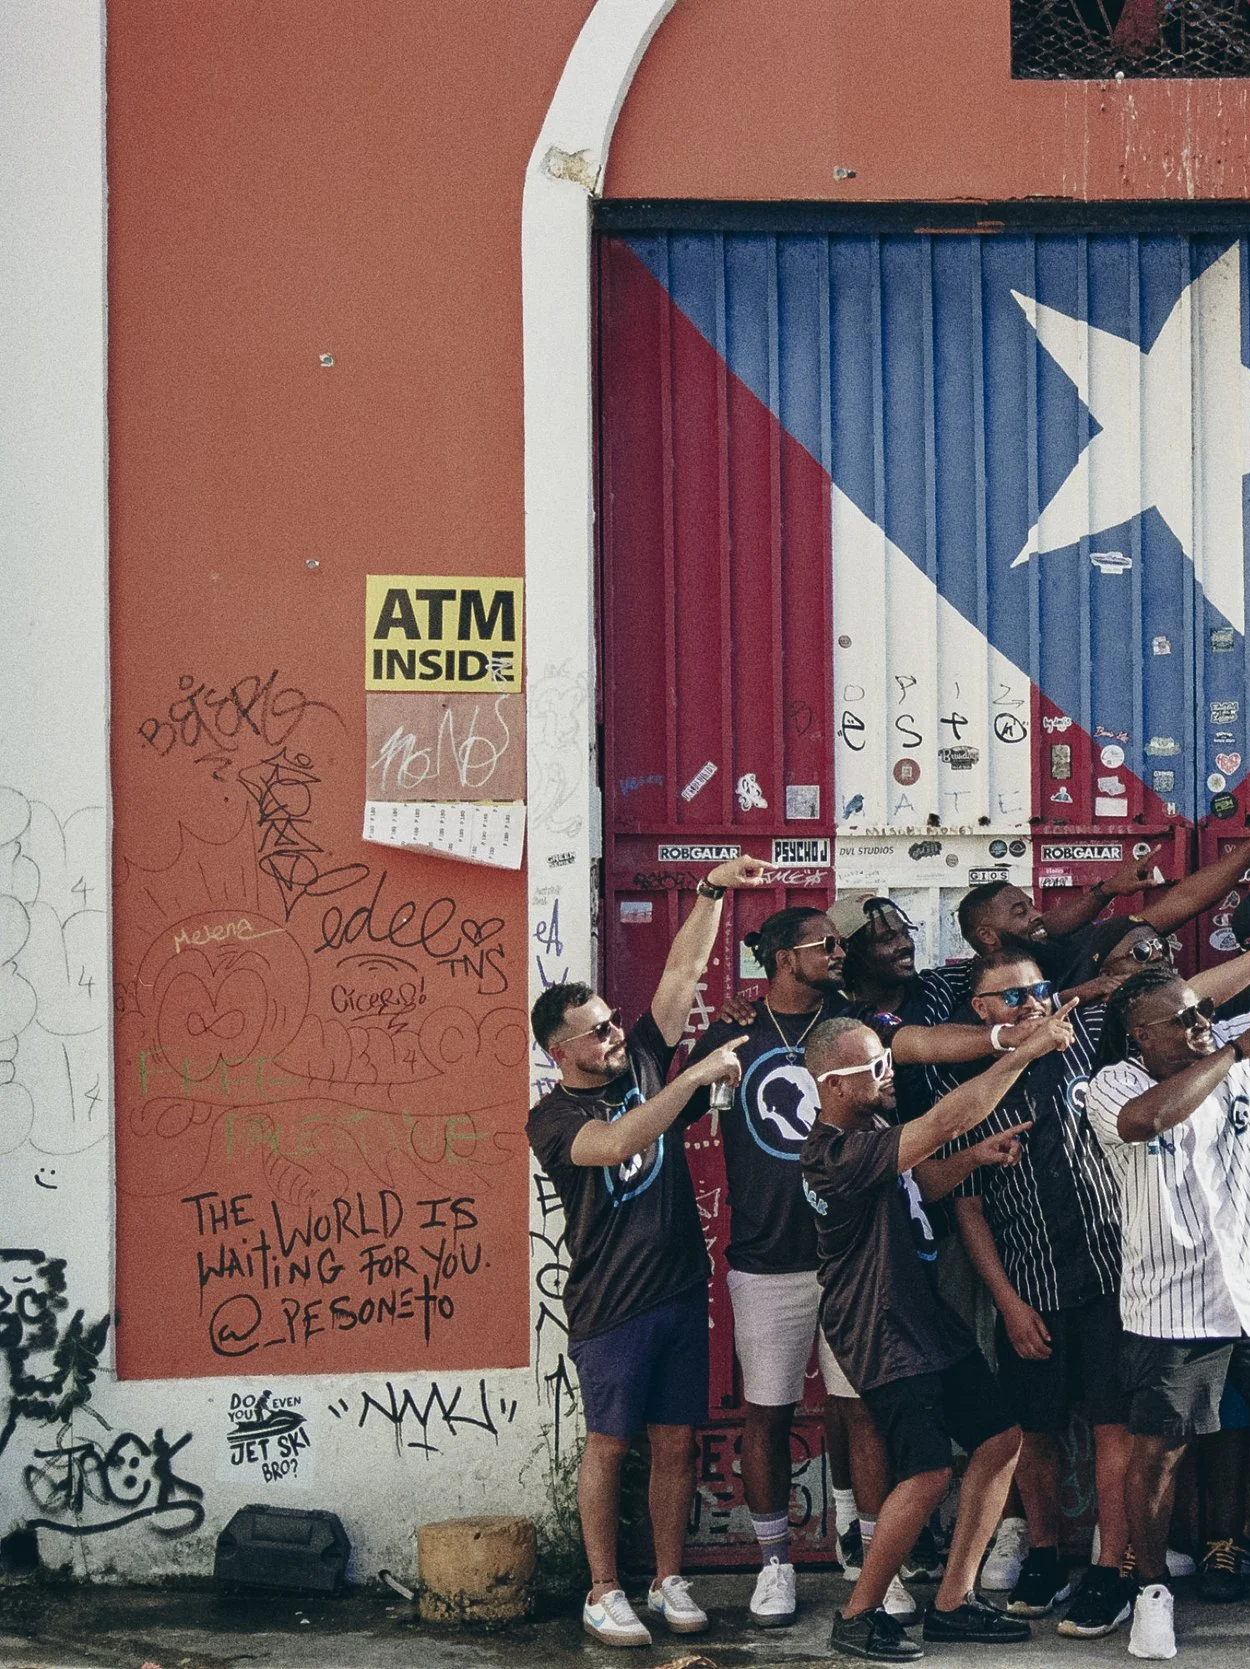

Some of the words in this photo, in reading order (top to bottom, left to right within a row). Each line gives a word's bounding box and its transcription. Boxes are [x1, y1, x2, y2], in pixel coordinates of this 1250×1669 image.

[373, 588, 515, 641] ATM
[373, 649, 515, 681] INSIDE
[661, 846, 739, 860] ROBGALAR
[774, 841, 818, 862] PSYCHO
[857, 846, 894, 855] STUDIOS
[1043, 847, 1120, 860] ROBGALAR
[970, 871, 1008, 880] GIOS
[182, 1192, 254, 1235] THE
[272, 1190, 403, 1257] WORLD
[416, 1197, 478, 1231] IS
[360, 1244, 417, 1285] FOR
[230, 1393, 256, 1410] DO
[272, 1396, 301, 1409] EVEN
[228, 1409, 253, 1422] YOU
[230, 1439, 270, 1466] JET
[277, 1426, 310, 1458] SKI
[262, 1458, 298, 1483] BRO?
